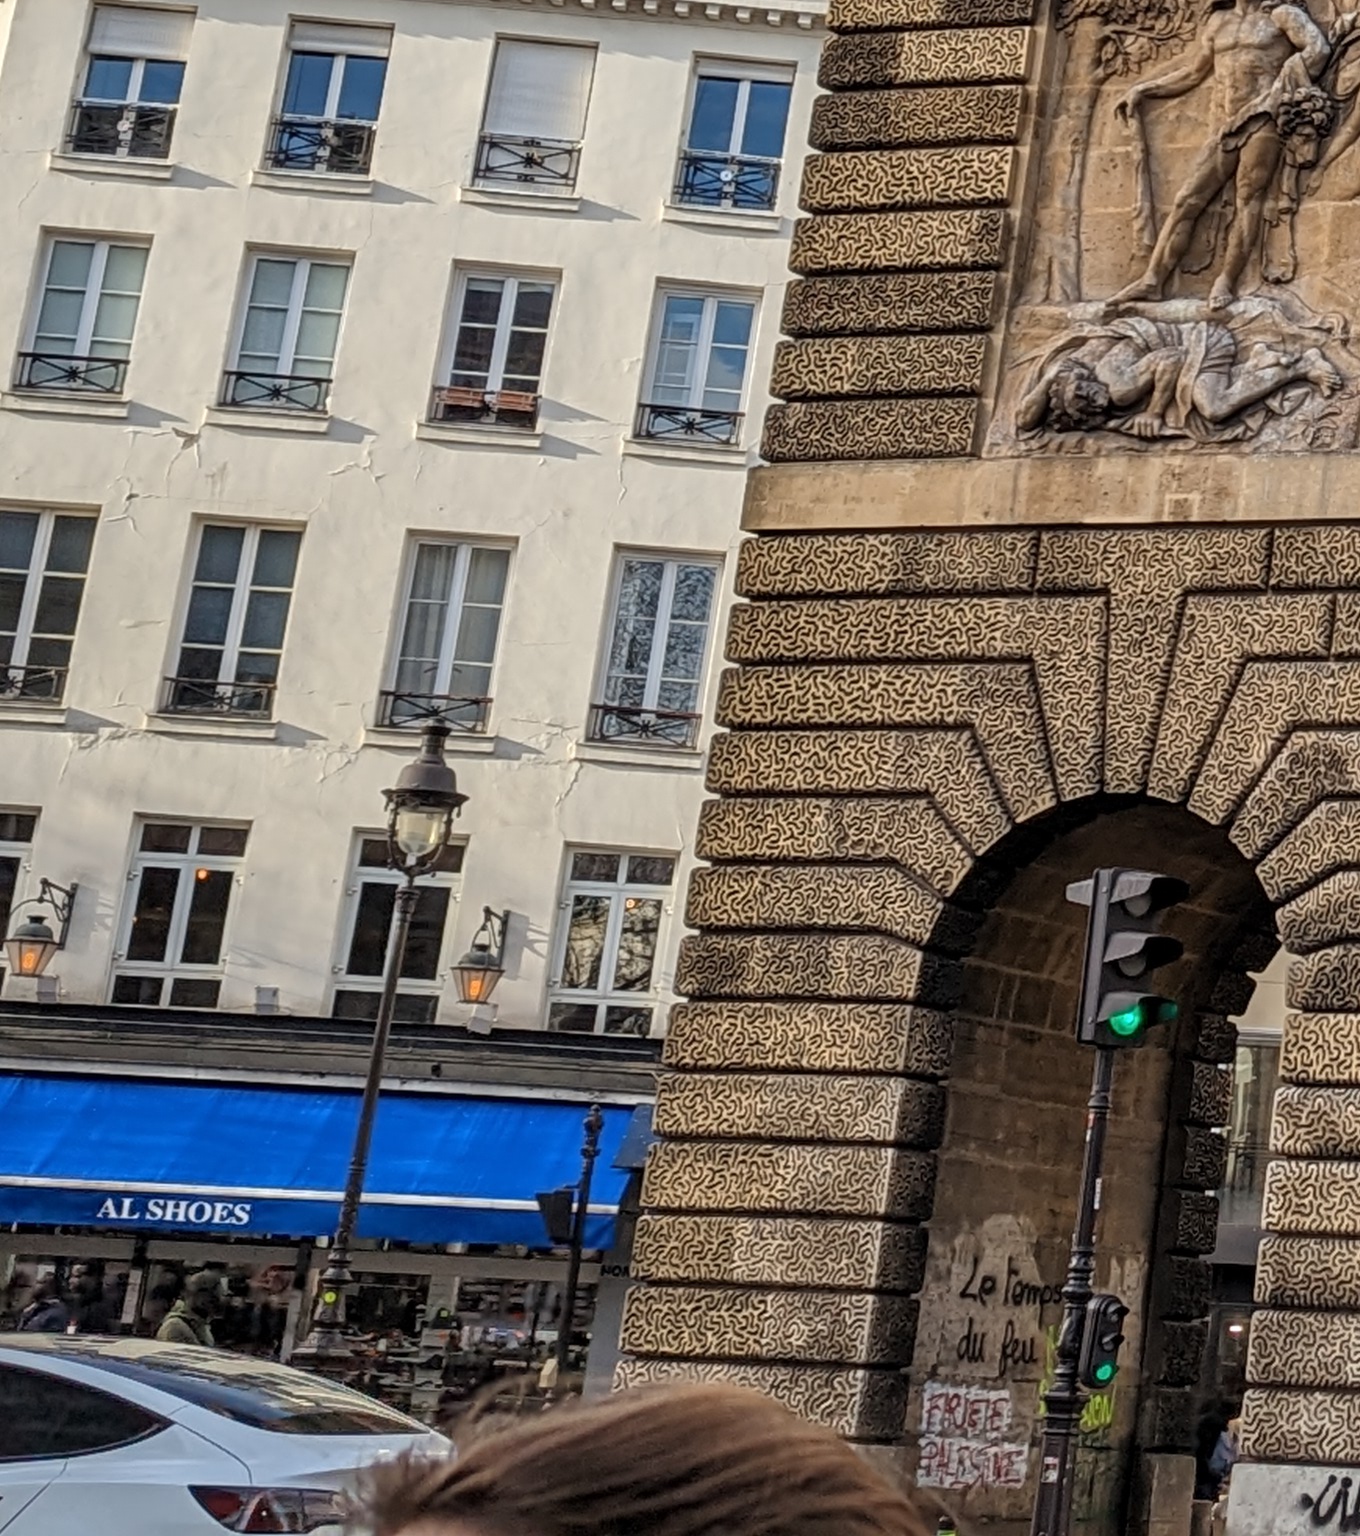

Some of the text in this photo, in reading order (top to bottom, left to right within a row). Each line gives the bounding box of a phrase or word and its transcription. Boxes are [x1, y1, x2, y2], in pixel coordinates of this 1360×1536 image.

[96, 1197, 252, 1225] AL SHOES
[956, 1316, 986, 1363] du
[999, 1318, 1038, 1378] feu
